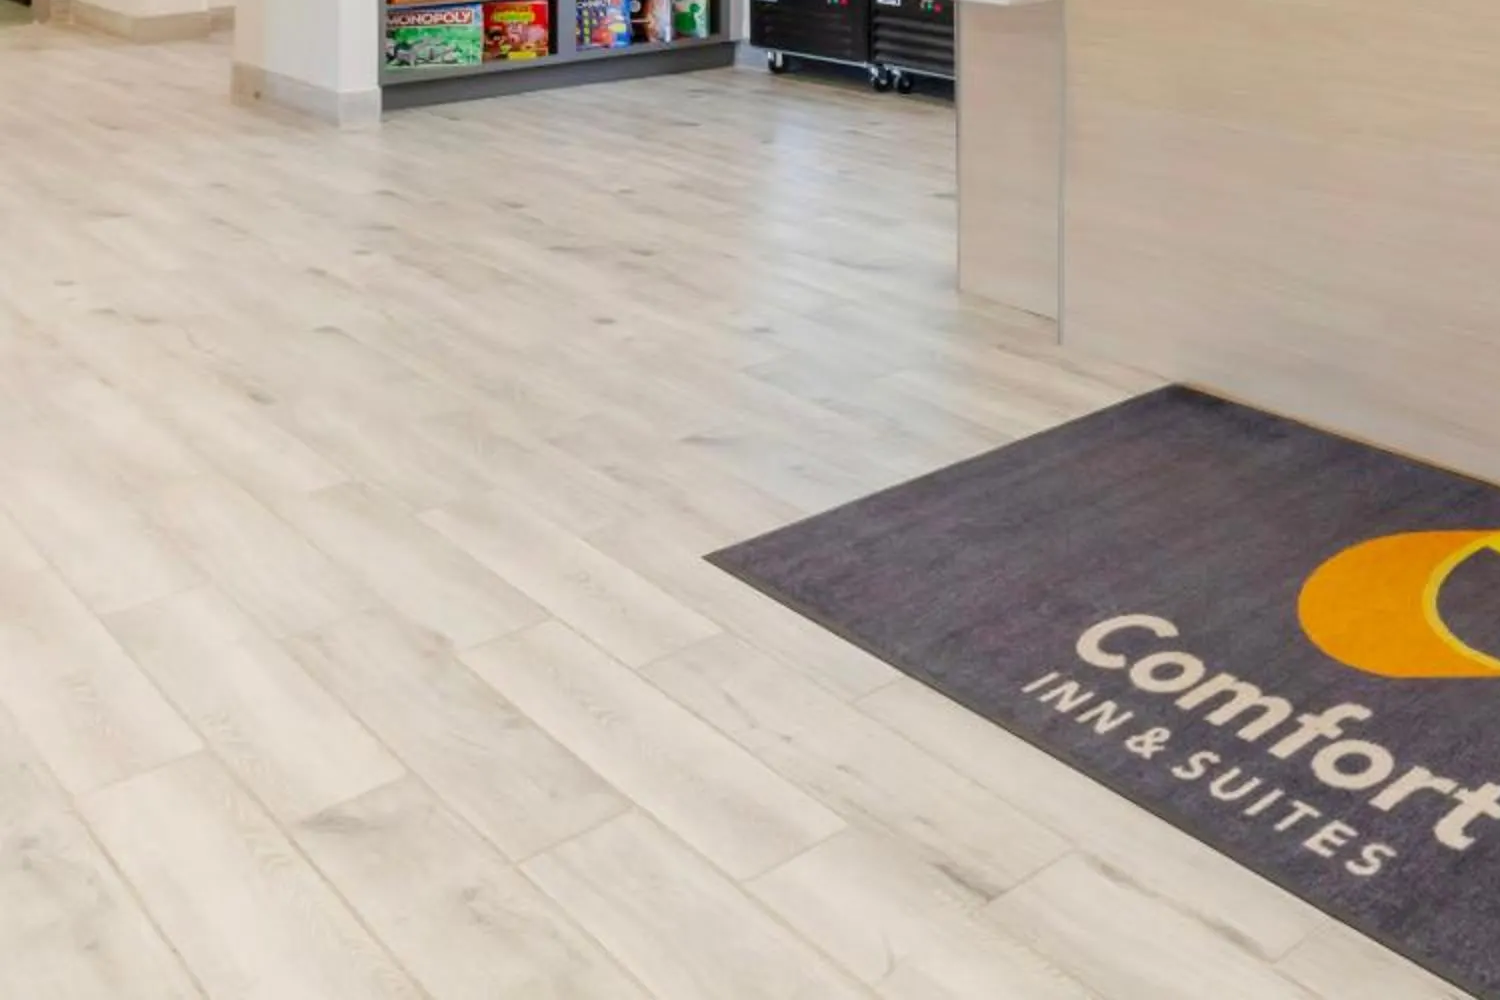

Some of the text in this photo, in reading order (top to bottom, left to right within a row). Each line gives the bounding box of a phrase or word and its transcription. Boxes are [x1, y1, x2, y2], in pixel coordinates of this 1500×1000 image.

[387, 11, 472, 26] MONOPOLY
[1021, 671, 1397, 876] INN & SUITES
